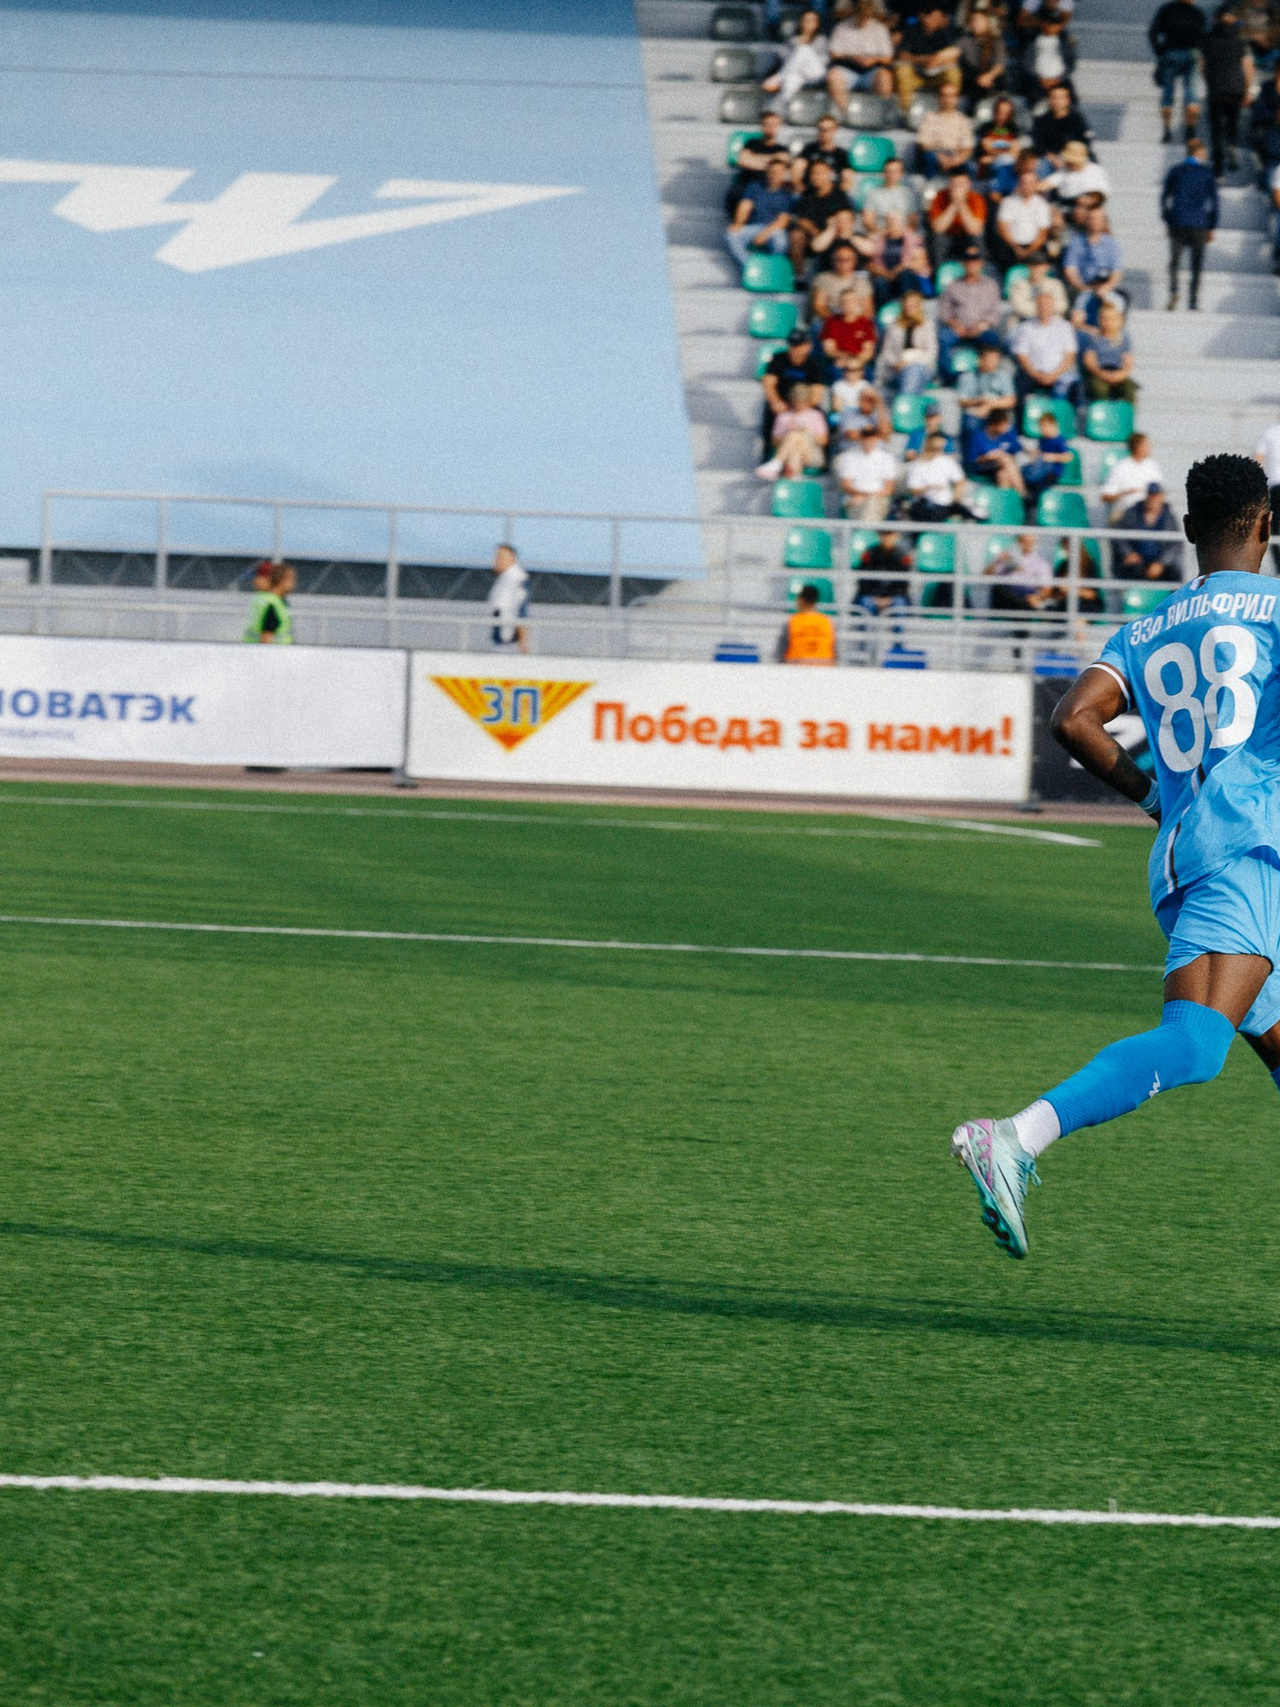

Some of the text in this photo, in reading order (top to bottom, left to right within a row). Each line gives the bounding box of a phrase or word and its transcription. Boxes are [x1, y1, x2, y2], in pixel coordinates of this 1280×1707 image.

[1130, 592, 1278, 646] ЭЗА ВИЛЬФРИД
[0, 688, 196, 724] ОВАТЭК
[1143, 624, 1258, 773] 88
[592, 700, 1013, 756] Победа за нами!
